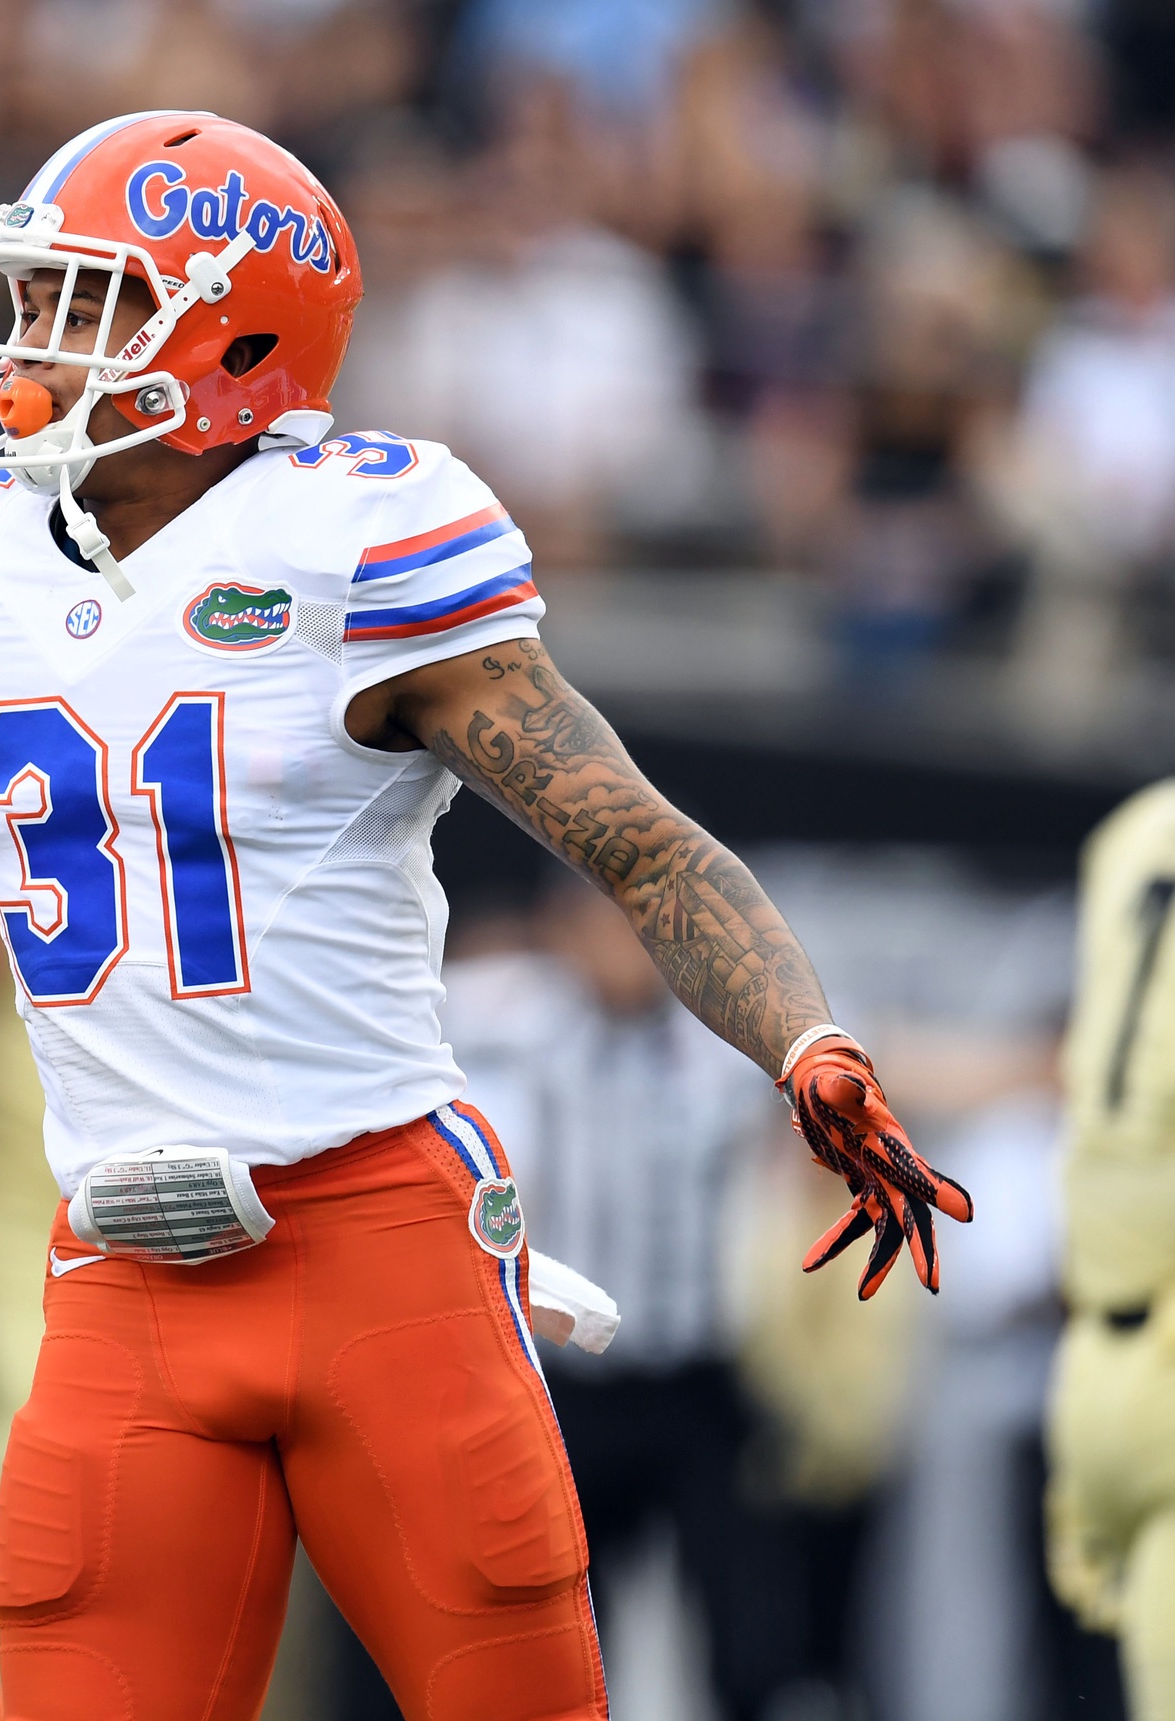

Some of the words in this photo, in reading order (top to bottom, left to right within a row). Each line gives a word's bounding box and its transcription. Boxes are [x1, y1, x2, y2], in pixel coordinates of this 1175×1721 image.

[126, 160, 330, 273] Gators
[161, 278, 185, 289] PEED
[67, 601, 101, 638] SEC
[467, 710, 640, 882] GRIND
